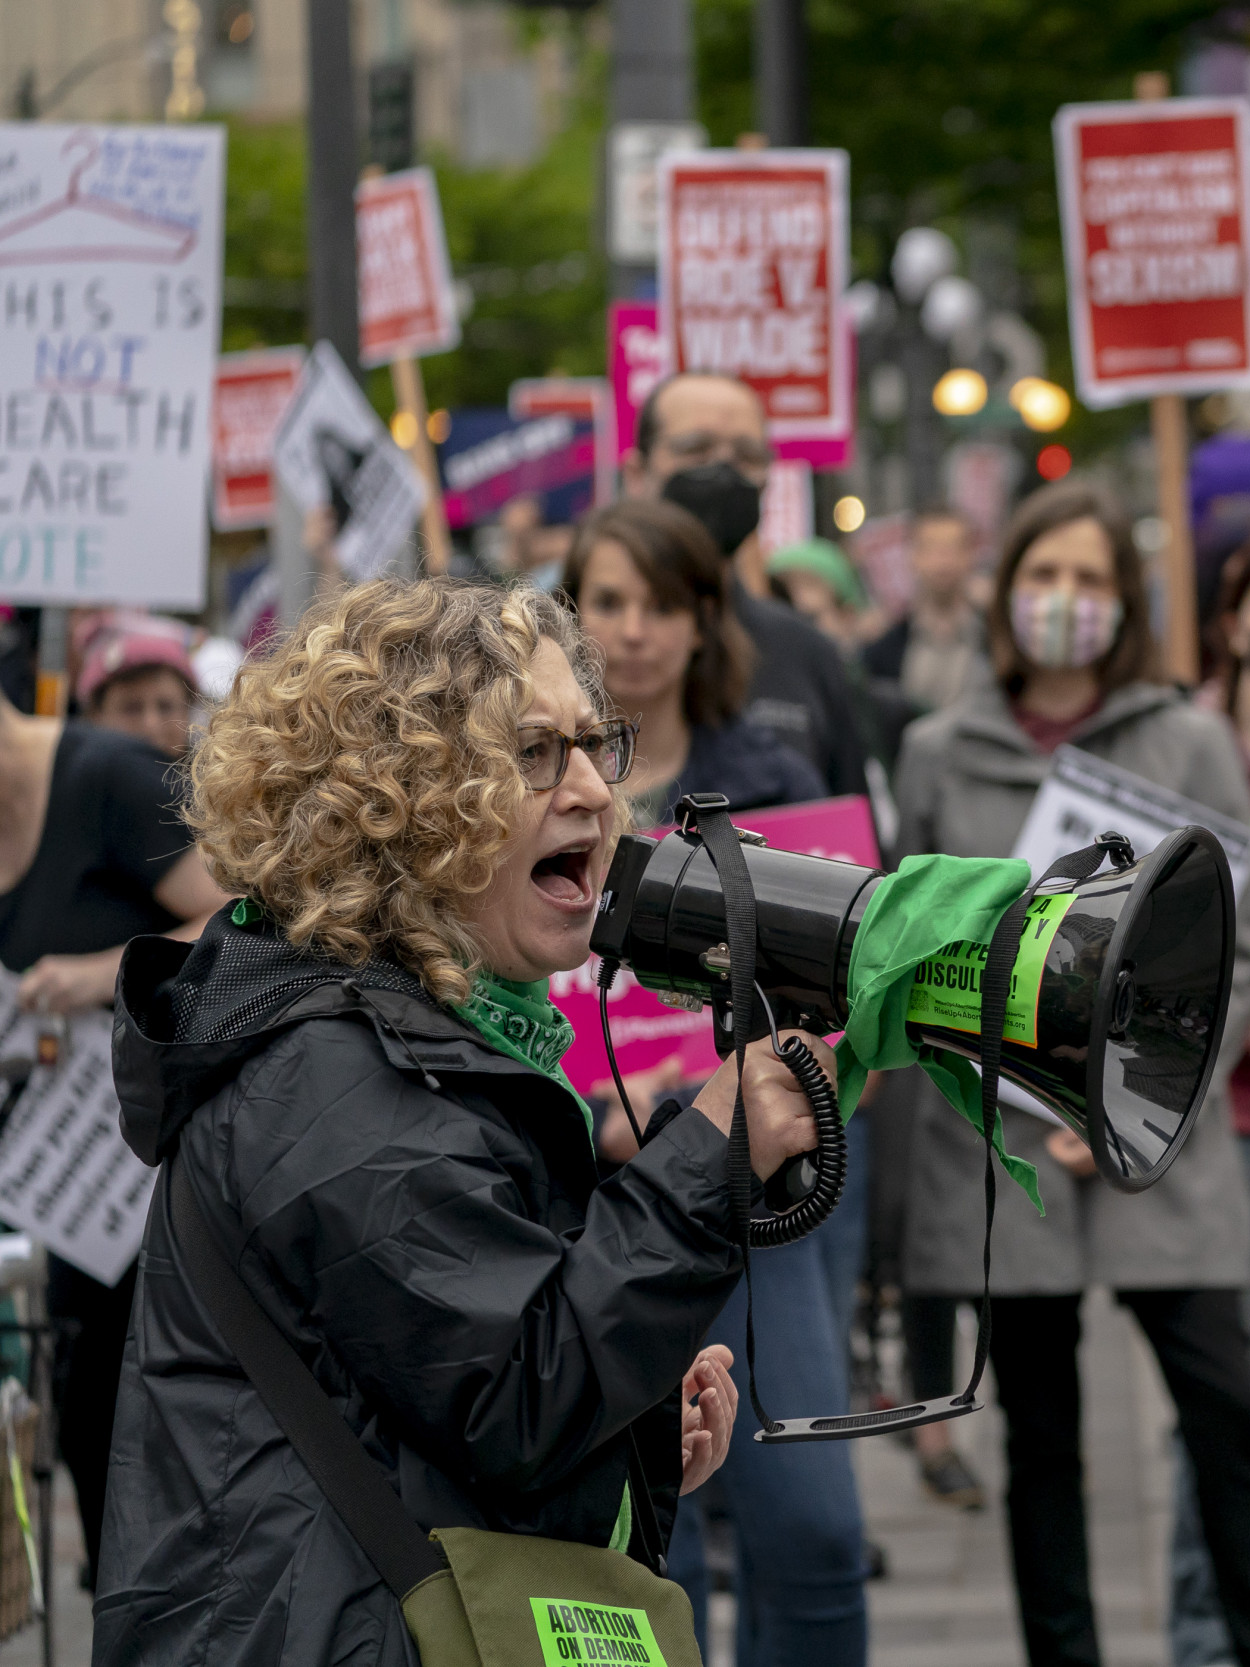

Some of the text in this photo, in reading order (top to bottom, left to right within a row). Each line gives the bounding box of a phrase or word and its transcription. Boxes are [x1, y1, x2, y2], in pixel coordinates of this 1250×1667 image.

[677, 204, 820, 251] DEFEND
[5, 273, 205, 331] HIS IS
[679, 255, 769, 302] ROE
[35, 334, 146, 386] NOT
[681, 320, 823, 374] WADE
[5, 384, 197, 459] EALTH
[0, 521, 106, 591] OTE
[1034, 918, 1050, 940] Y
[914, 961, 1018, 1000] DISCUL!
[547, 1604, 641, 1640] ABORTION
[556, 1637, 651, 1663] ON DEMAND
